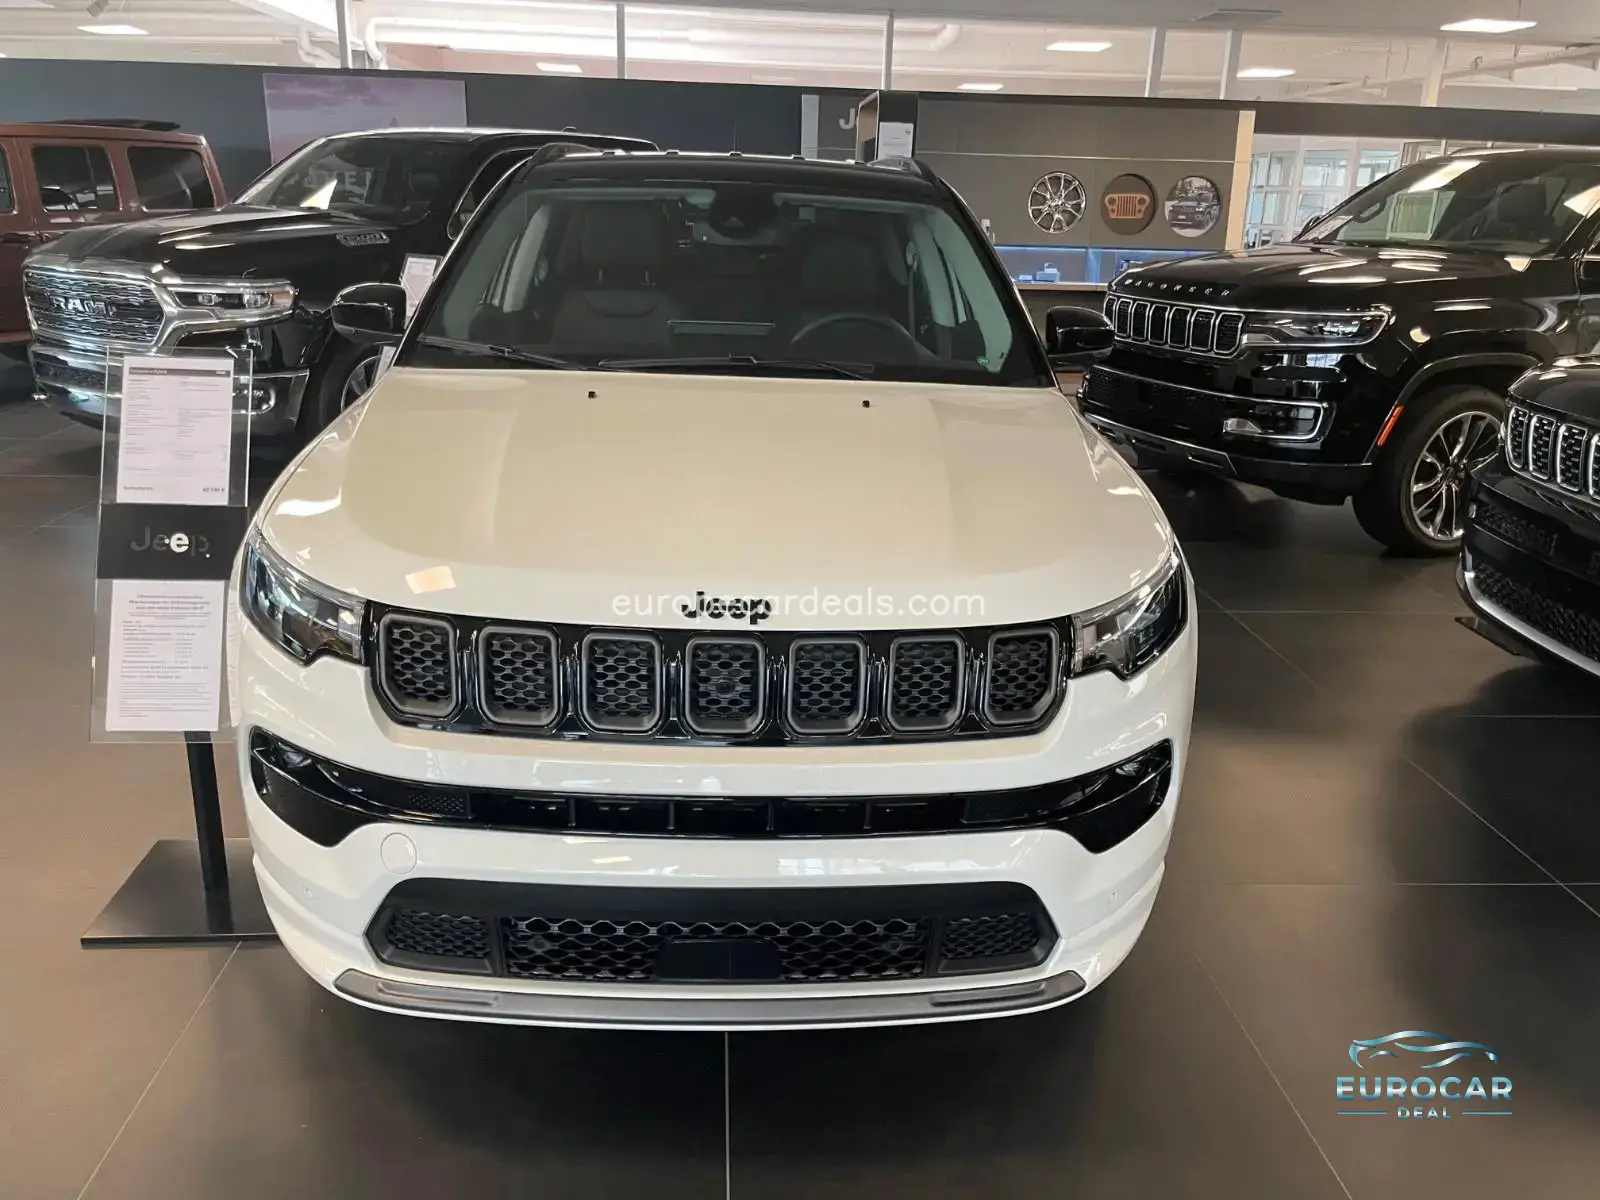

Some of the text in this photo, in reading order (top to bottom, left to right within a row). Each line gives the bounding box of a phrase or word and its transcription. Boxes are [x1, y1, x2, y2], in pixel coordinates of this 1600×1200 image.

[52, 296, 107, 316] RAM
[130, 526, 210, 557] Jeep
[681, 591, 771, 625] Jeep
